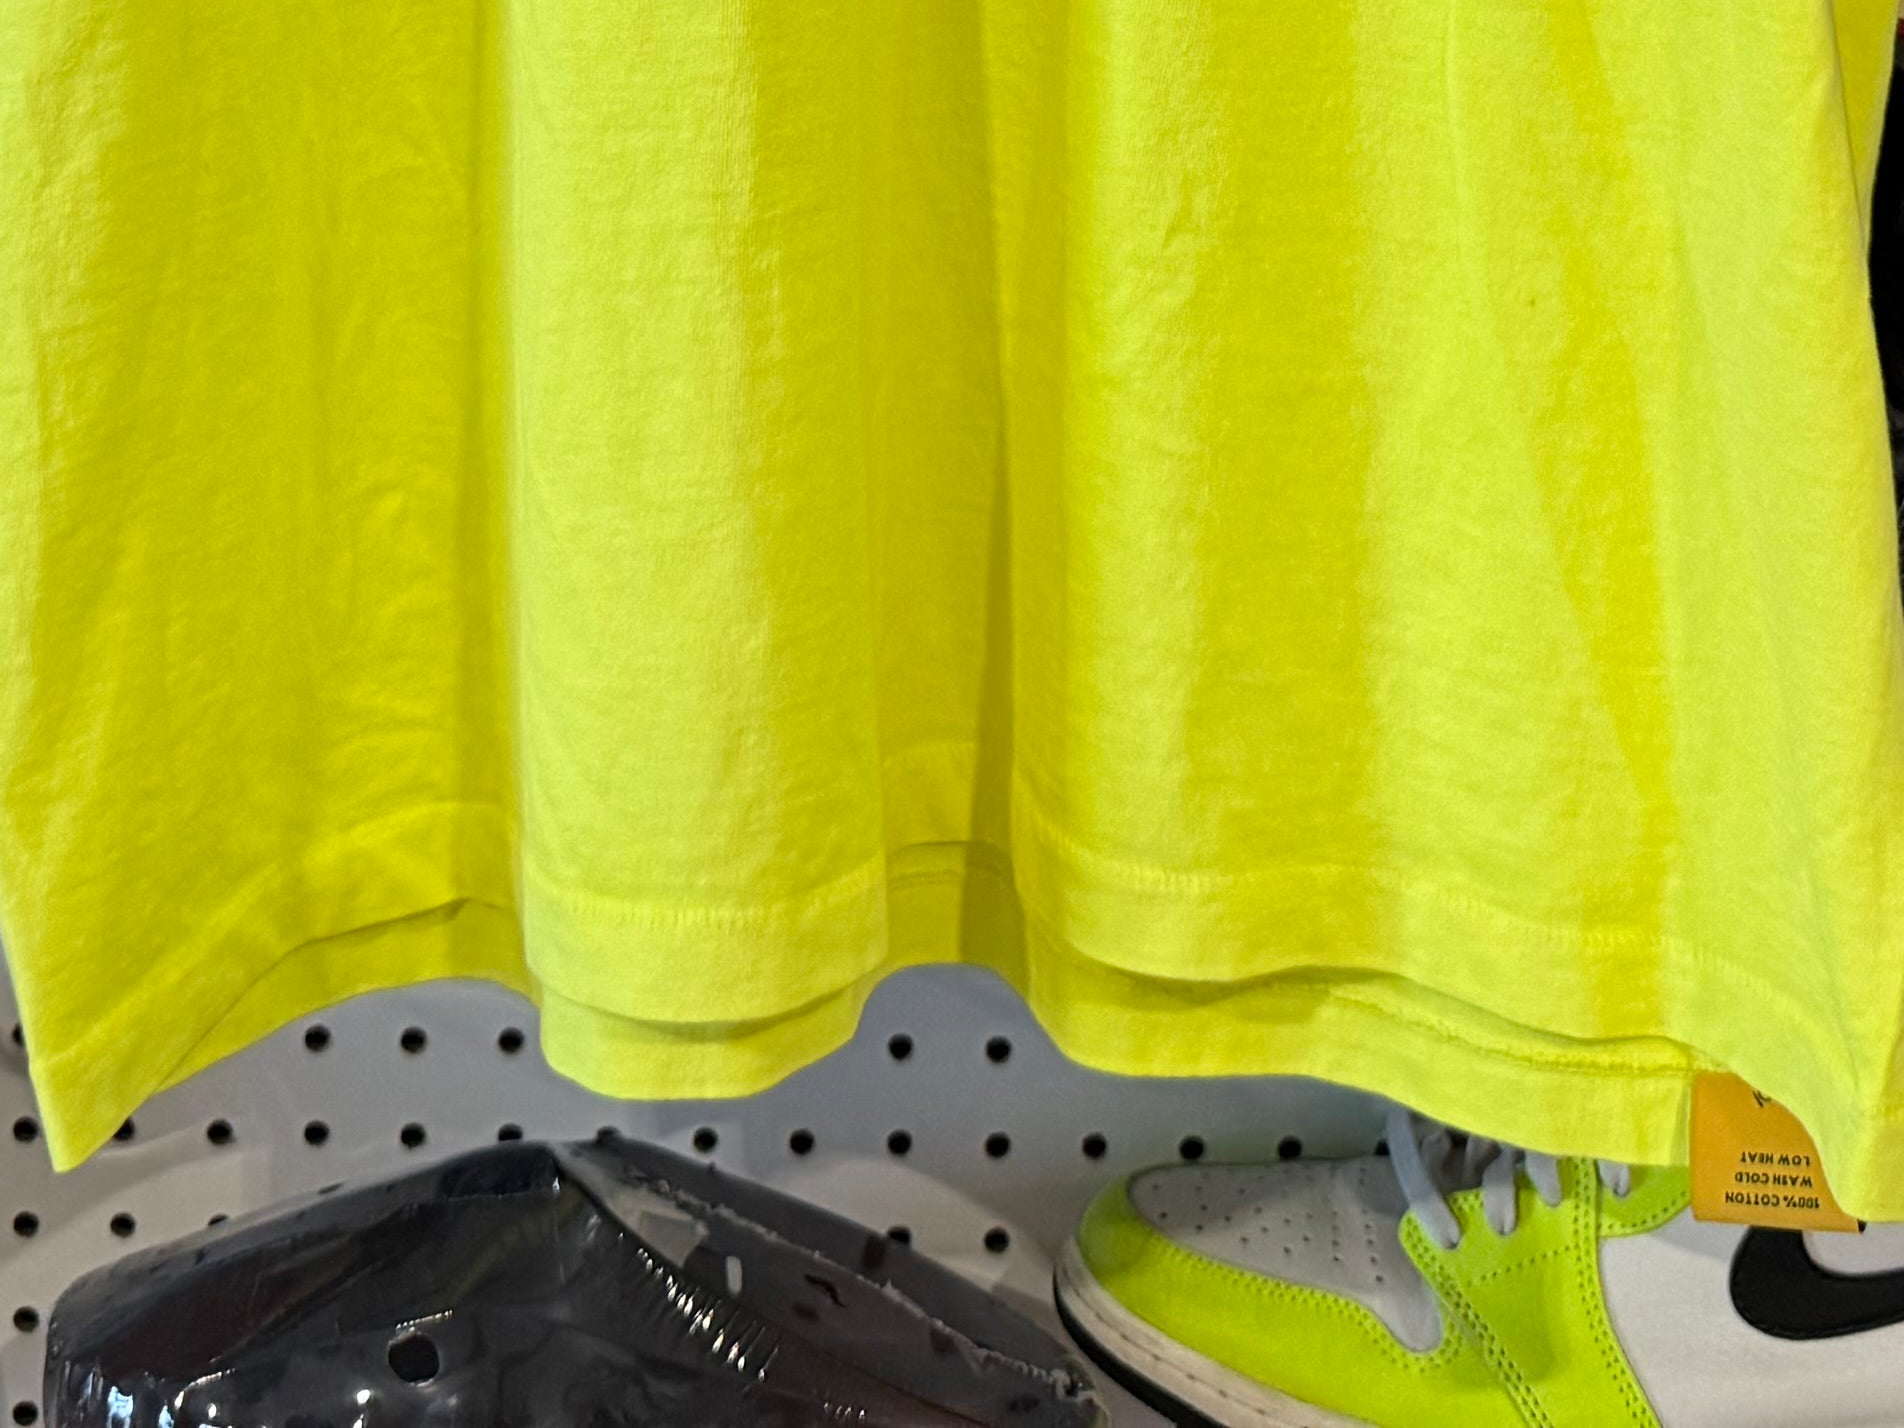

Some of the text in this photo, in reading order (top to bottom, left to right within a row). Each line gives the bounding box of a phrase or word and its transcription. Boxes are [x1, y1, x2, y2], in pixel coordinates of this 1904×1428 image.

[1739, 1150, 1811, 1167] LOW HEAT
[1734, 1171, 1813, 1188] WASH COLD
[1725, 1191, 1820, 1210] 100% COTTON
